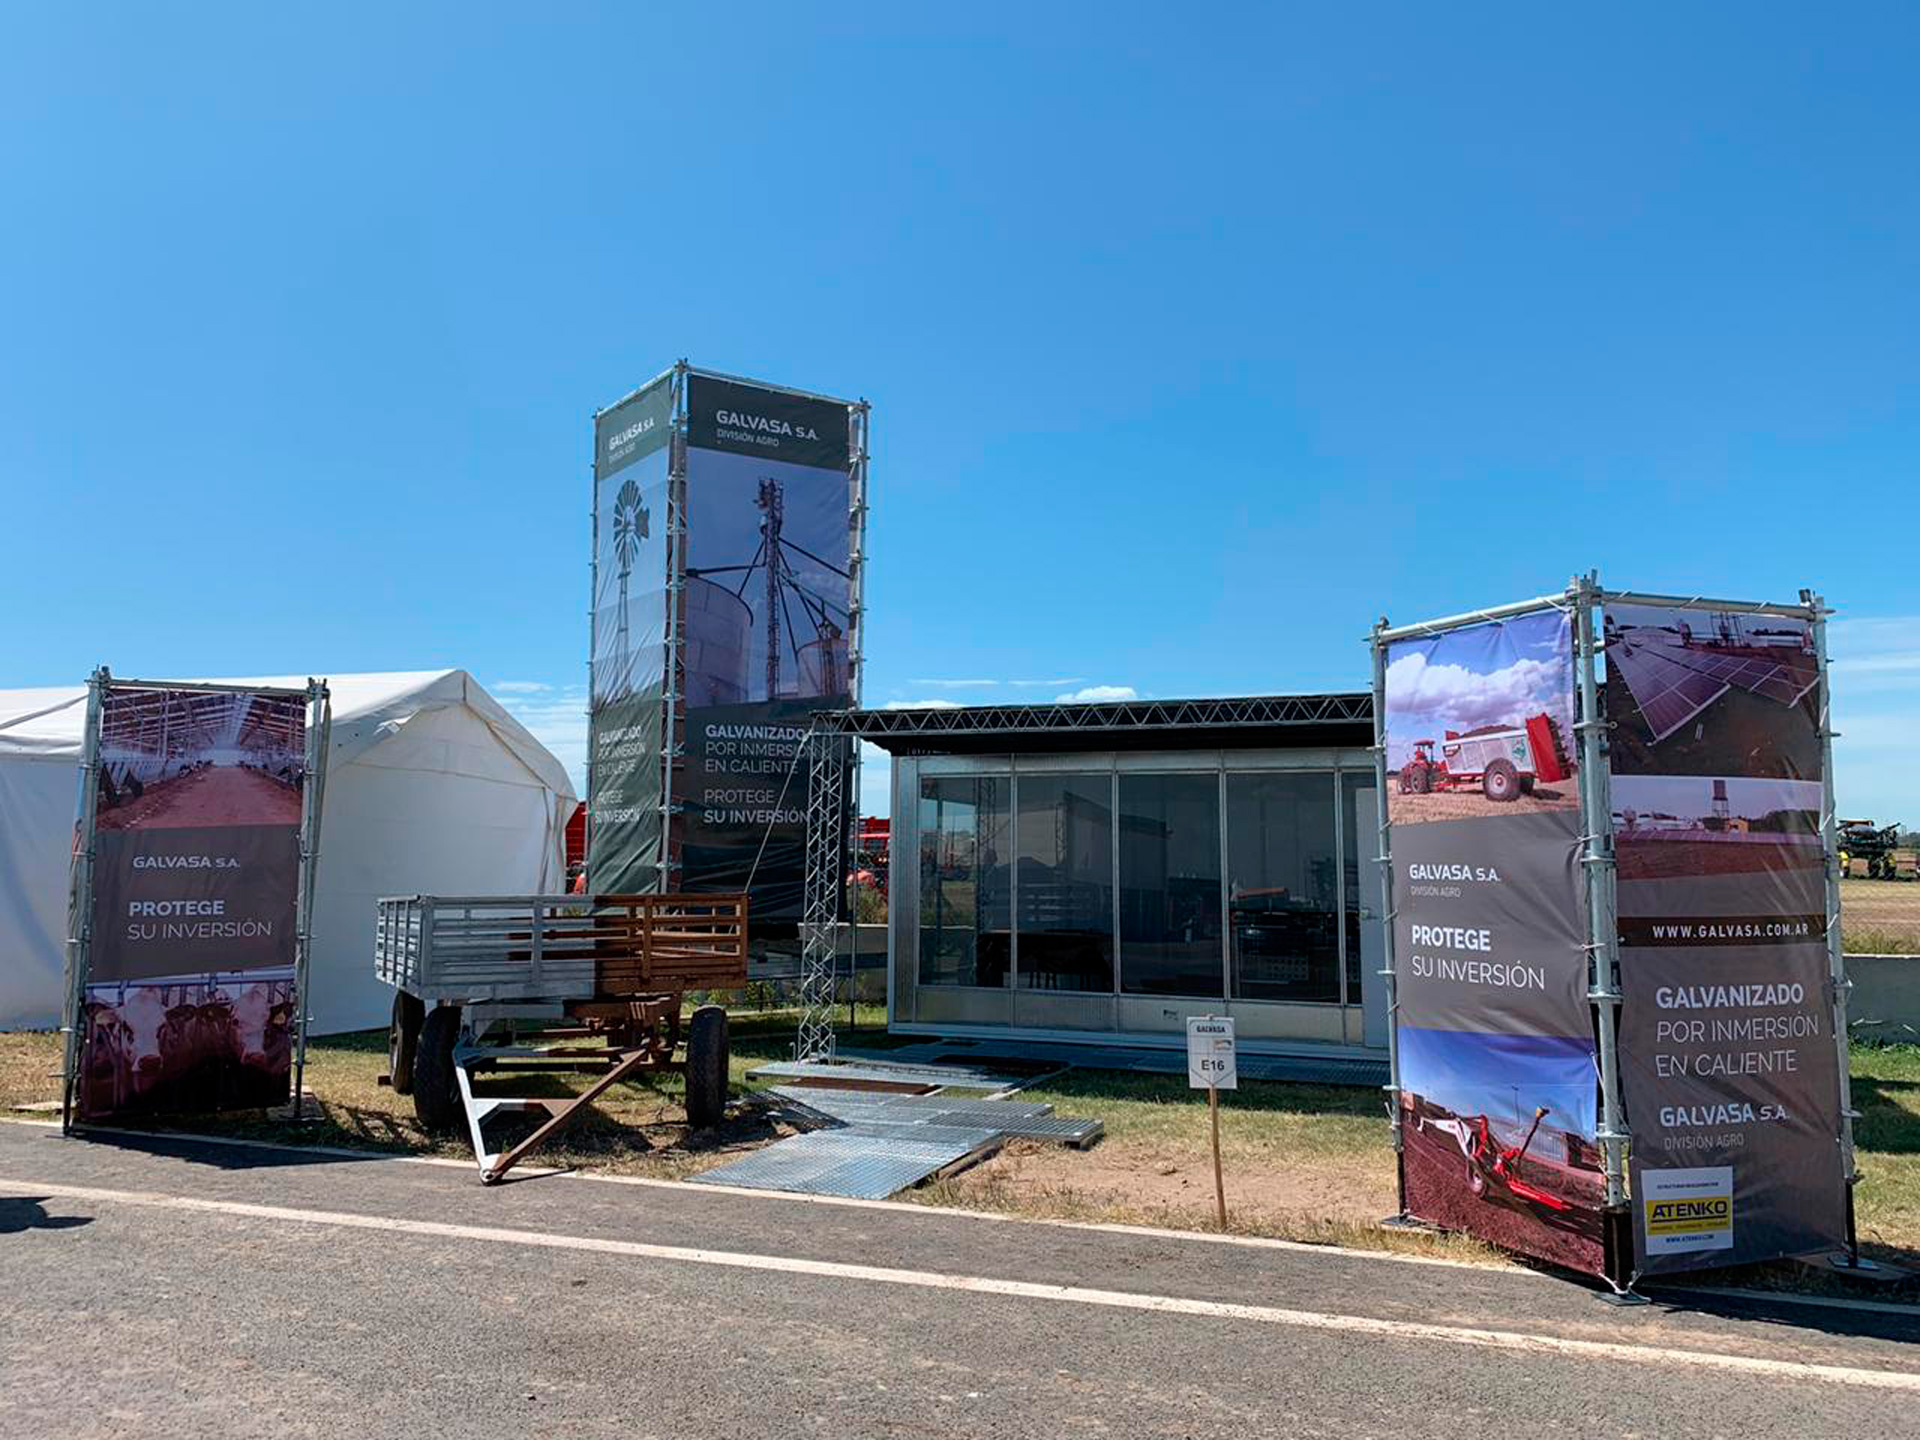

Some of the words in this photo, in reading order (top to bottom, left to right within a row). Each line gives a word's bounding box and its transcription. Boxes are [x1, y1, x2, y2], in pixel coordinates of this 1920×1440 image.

[716, 409, 793, 437] GALVASA
[756, 435, 780, 447] AGRO
[705, 724, 806, 741] GALVANIZADO
[705, 741, 737, 756] POR
[705, 759, 727, 773] EN
[730, 760, 798, 775] CALIENTE
[704, 789, 775, 804] PROTEGE
[703, 810, 726, 824] SU
[729, 806, 810, 824] INVERSIÓN
[132, 855, 212, 869] GALVASA
[215, 857, 241, 868] S.A.
[1409, 864, 1473, 881] GALVASA
[1475, 867, 1501, 882] S.A.
[128, 900, 224, 917] PROTEGE
[127, 923, 157, 940] SU
[161, 918, 272, 939] INVERSIÓN
[1411, 925, 1491, 951] PROTEGE
[1652, 923, 1809, 938] WWW.GALVASA.COM.AR
[1412, 955, 1434, 977] SU
[1437, 958, 1546, 990] INVERSIÓN
[1656, 983, 1804, 1009] GALVANIZADO
[1656, 1020, 1705, 1043] POR
[1711, 1010, 1819, 1042] INMERSIÓN
[1201, 1059, 1225, 1071] E16
[1656, 1054, 1688, 1077] EN
[1694, 1049, 1798, 1076] CALIENTE
[1659, 1103, 1755, 1127] GALVASA
[1759, 1104, 1791, 1121] S.A.
[1716, 1133, 1744, 1146] AGRO
[1652, 1200, 1728, 1218] ATENKO
